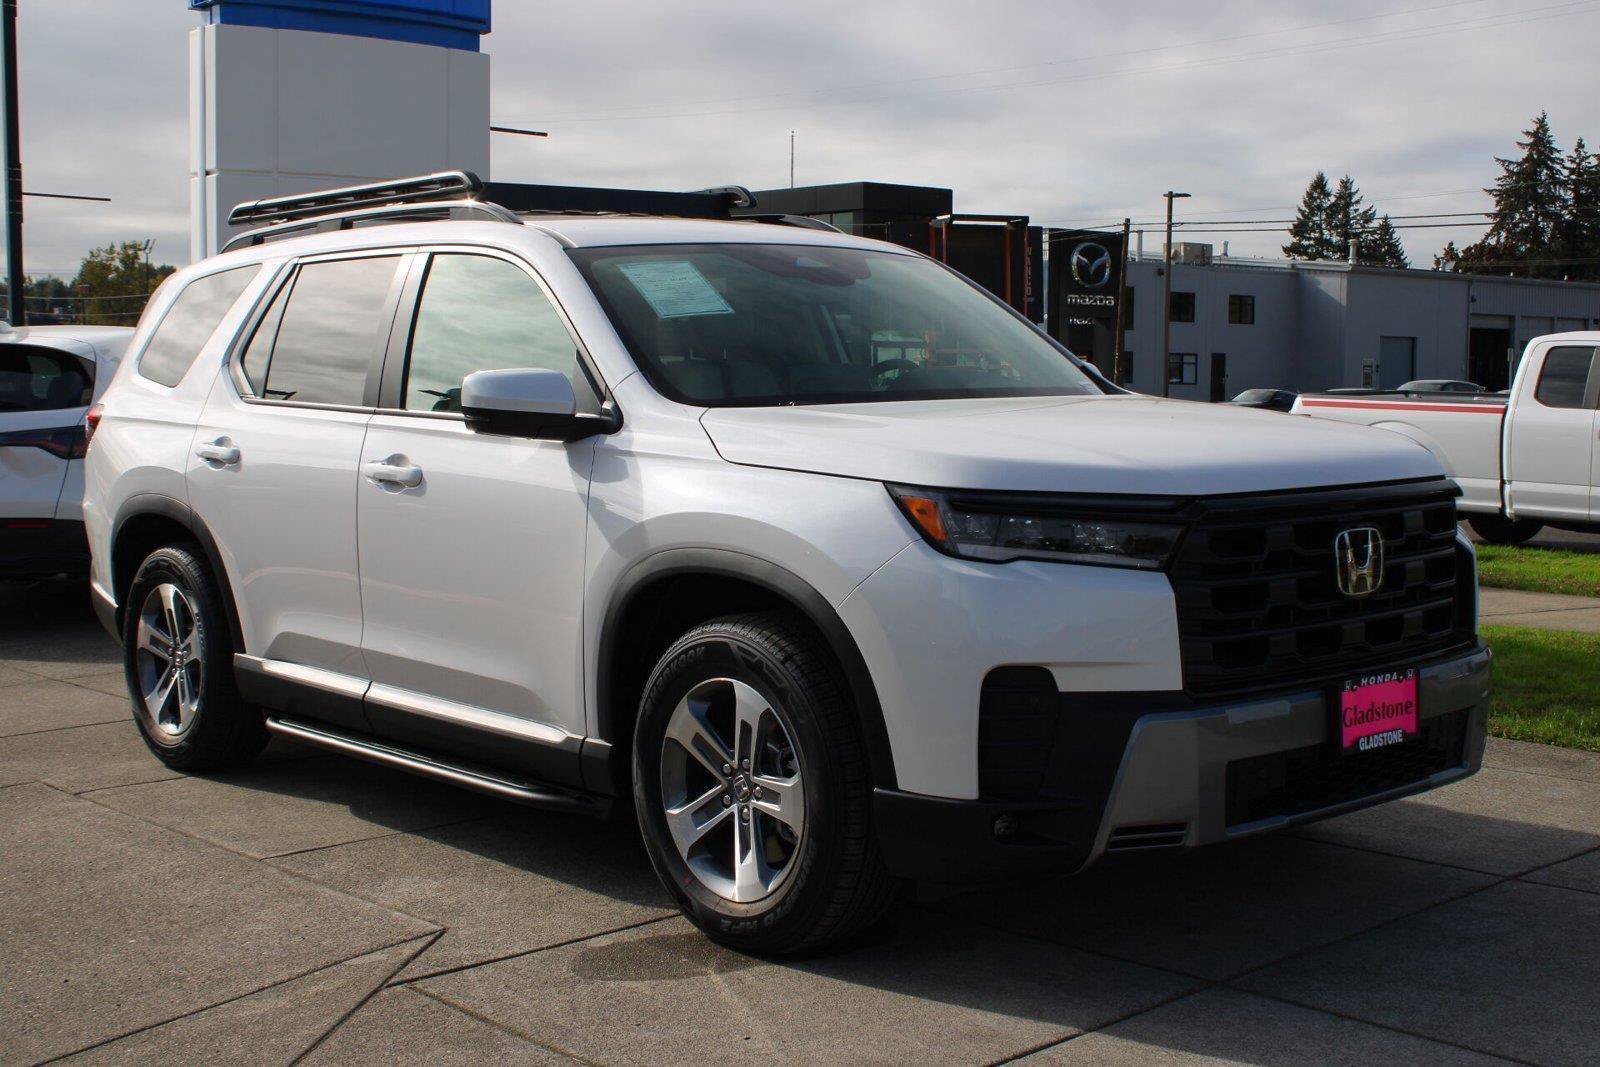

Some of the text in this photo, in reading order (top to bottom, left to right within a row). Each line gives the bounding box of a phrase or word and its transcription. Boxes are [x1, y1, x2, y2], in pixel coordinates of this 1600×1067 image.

[1361, 671, 1398, 687] HONDA
[1342, 700, 1413, 728] Gladstone
[1359, 729, 1403, 751] GLADSTONE
